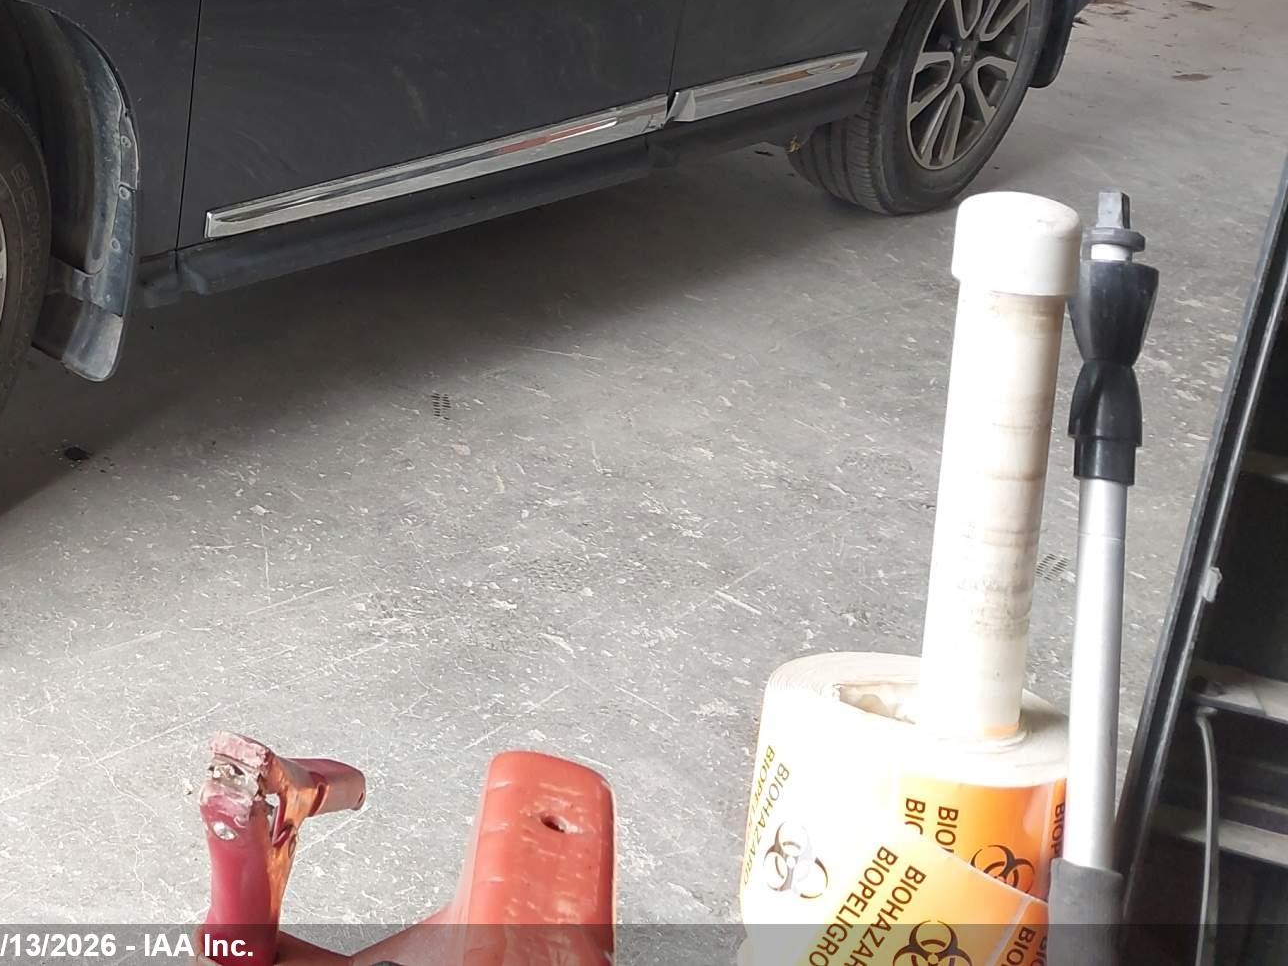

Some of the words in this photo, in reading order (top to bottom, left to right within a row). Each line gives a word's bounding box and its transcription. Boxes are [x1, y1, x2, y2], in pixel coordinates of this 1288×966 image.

[934, 805, 959, 853] BIO
[808, 846, 899, 966] BIOPELIGRO
[1001, 926, 1036, 966] BIO
